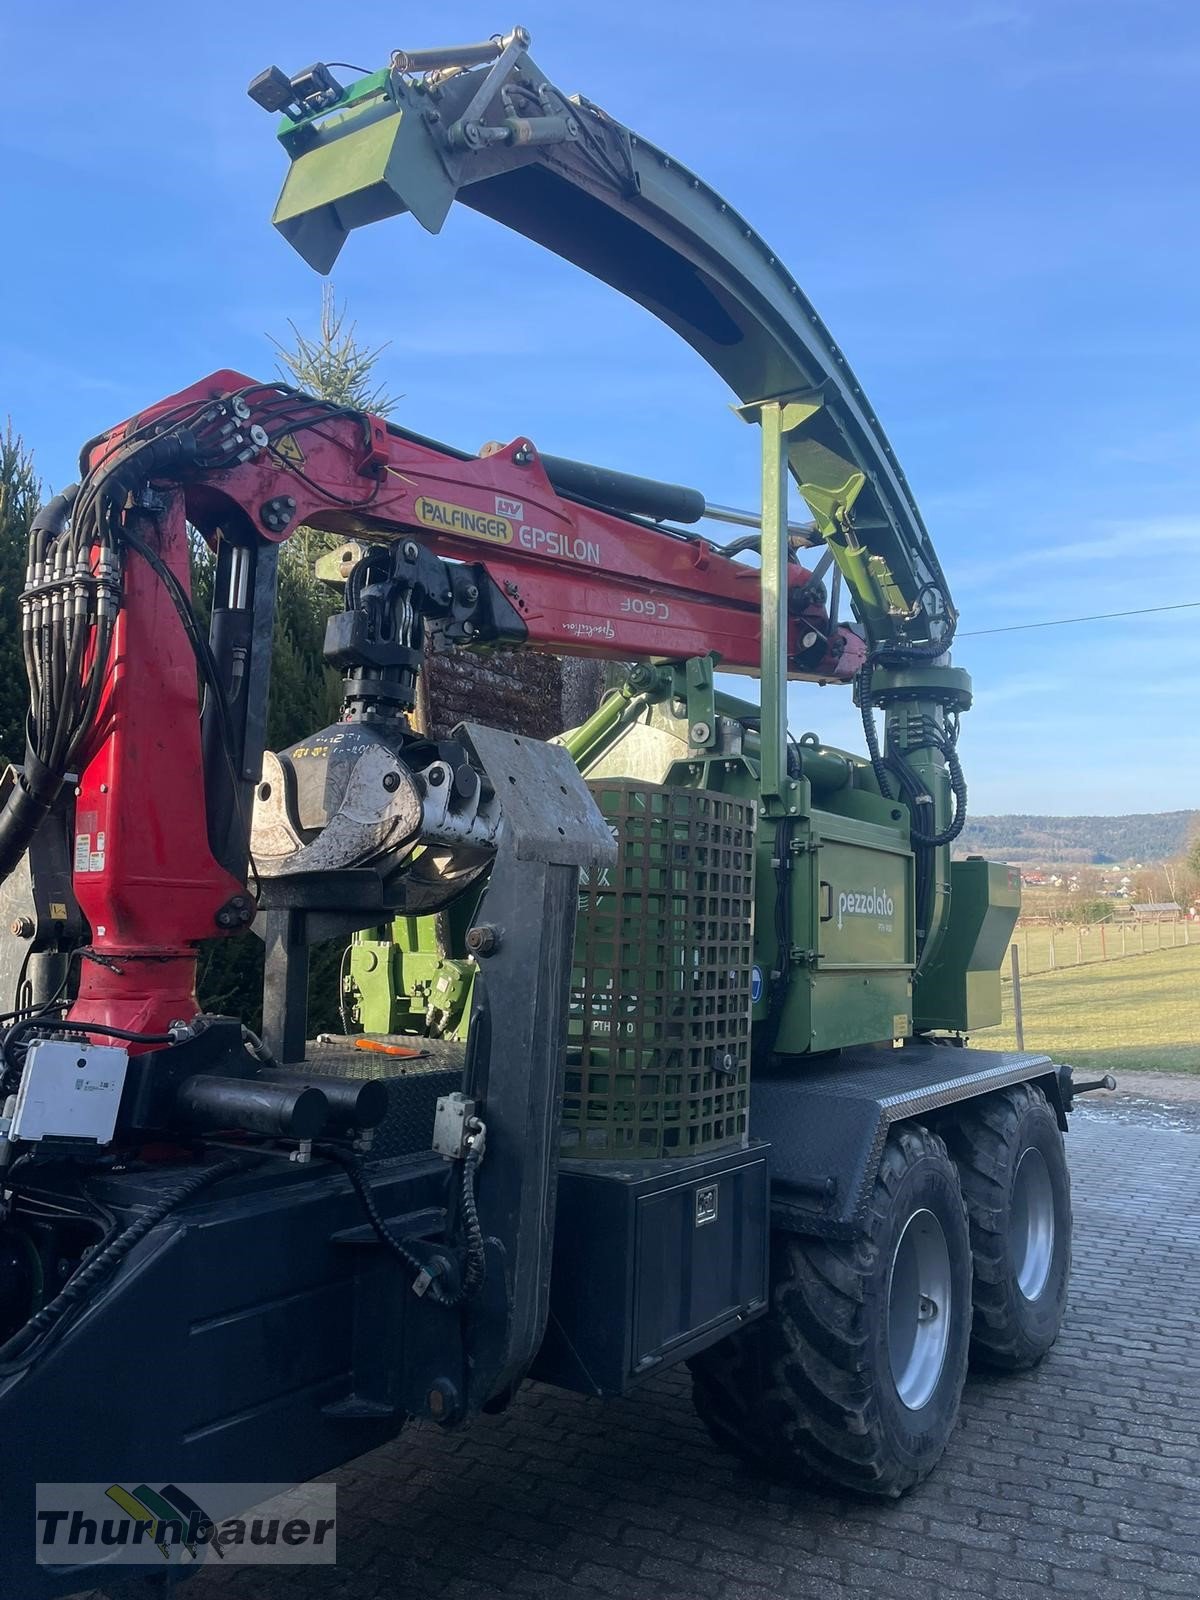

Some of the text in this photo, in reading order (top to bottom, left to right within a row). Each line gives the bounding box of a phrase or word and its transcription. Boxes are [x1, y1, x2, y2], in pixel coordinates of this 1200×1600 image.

[421, 501, 601, 564] PALFINGER EPSILON
[620, 597, 669, 620] C60F
[837, 886, 894, 931] pezzolato
[592, 1020, 611, 1032] PTH
